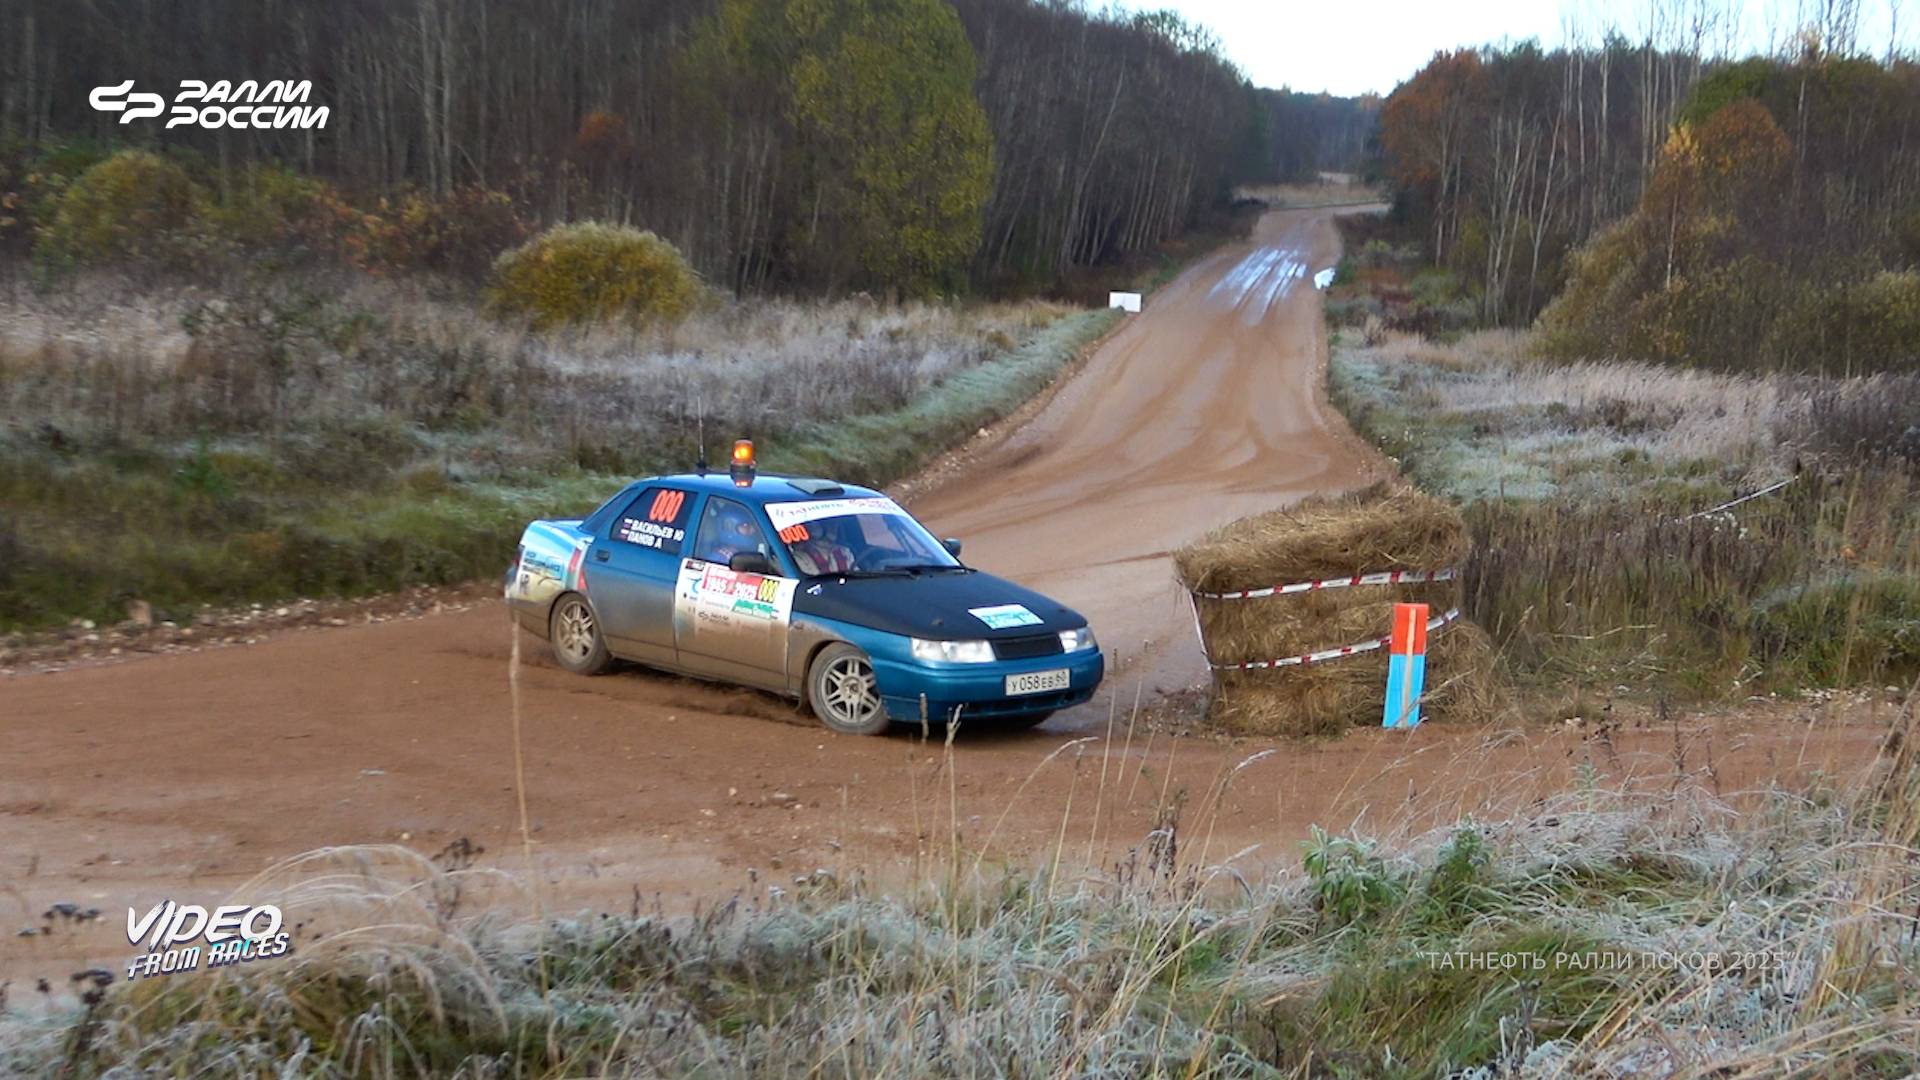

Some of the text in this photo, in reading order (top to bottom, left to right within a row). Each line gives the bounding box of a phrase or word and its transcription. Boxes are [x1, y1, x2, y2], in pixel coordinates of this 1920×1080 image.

[649, 490, 685, 523] 000
[631, 519, 675, 539] ВАСИЛЬЕВ
[780, 524, 809, 544] 000
[627, 531, 663, 549] ПАНОВ А
